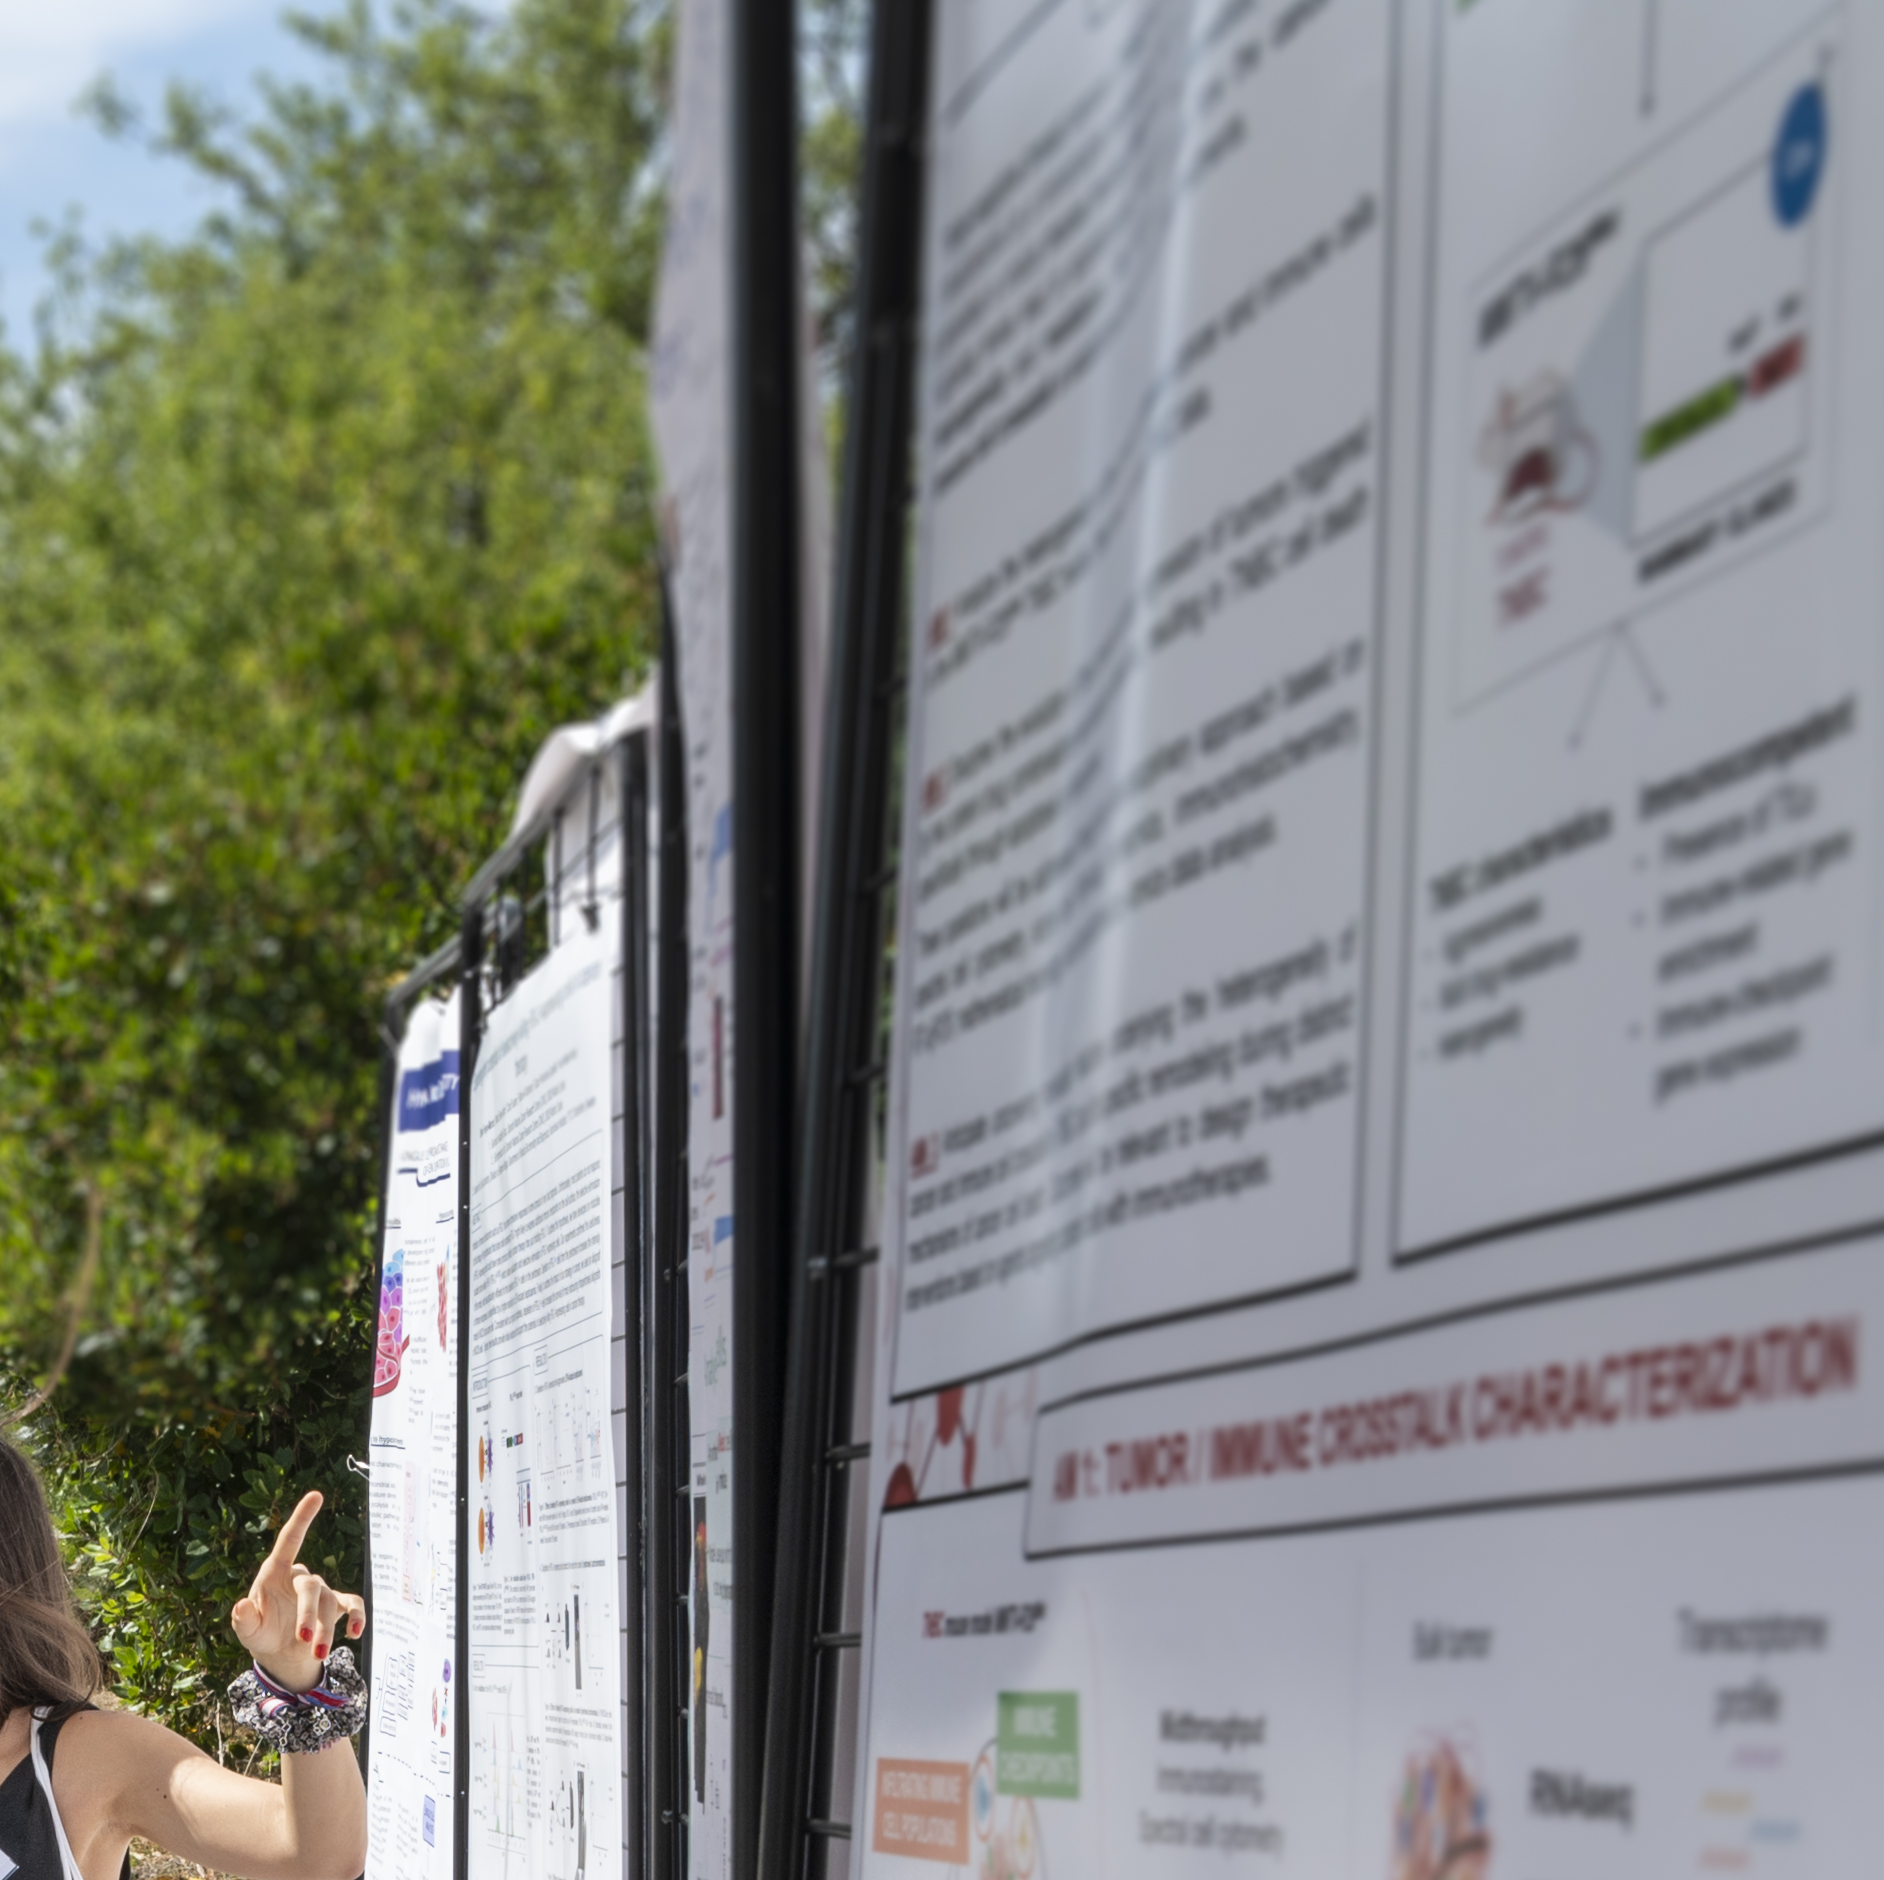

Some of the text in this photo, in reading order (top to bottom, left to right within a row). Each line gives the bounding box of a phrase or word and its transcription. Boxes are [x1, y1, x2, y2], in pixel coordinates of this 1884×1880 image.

[1105, 1430, 1187, 1495] TUMOR
[1209, 1412, 1312, 1483] IMMUNE
[1319, 1384, 1469, 1468] CROSSTALK
[1472, 1317, 1859, 1443] CHARACTERIZATION
